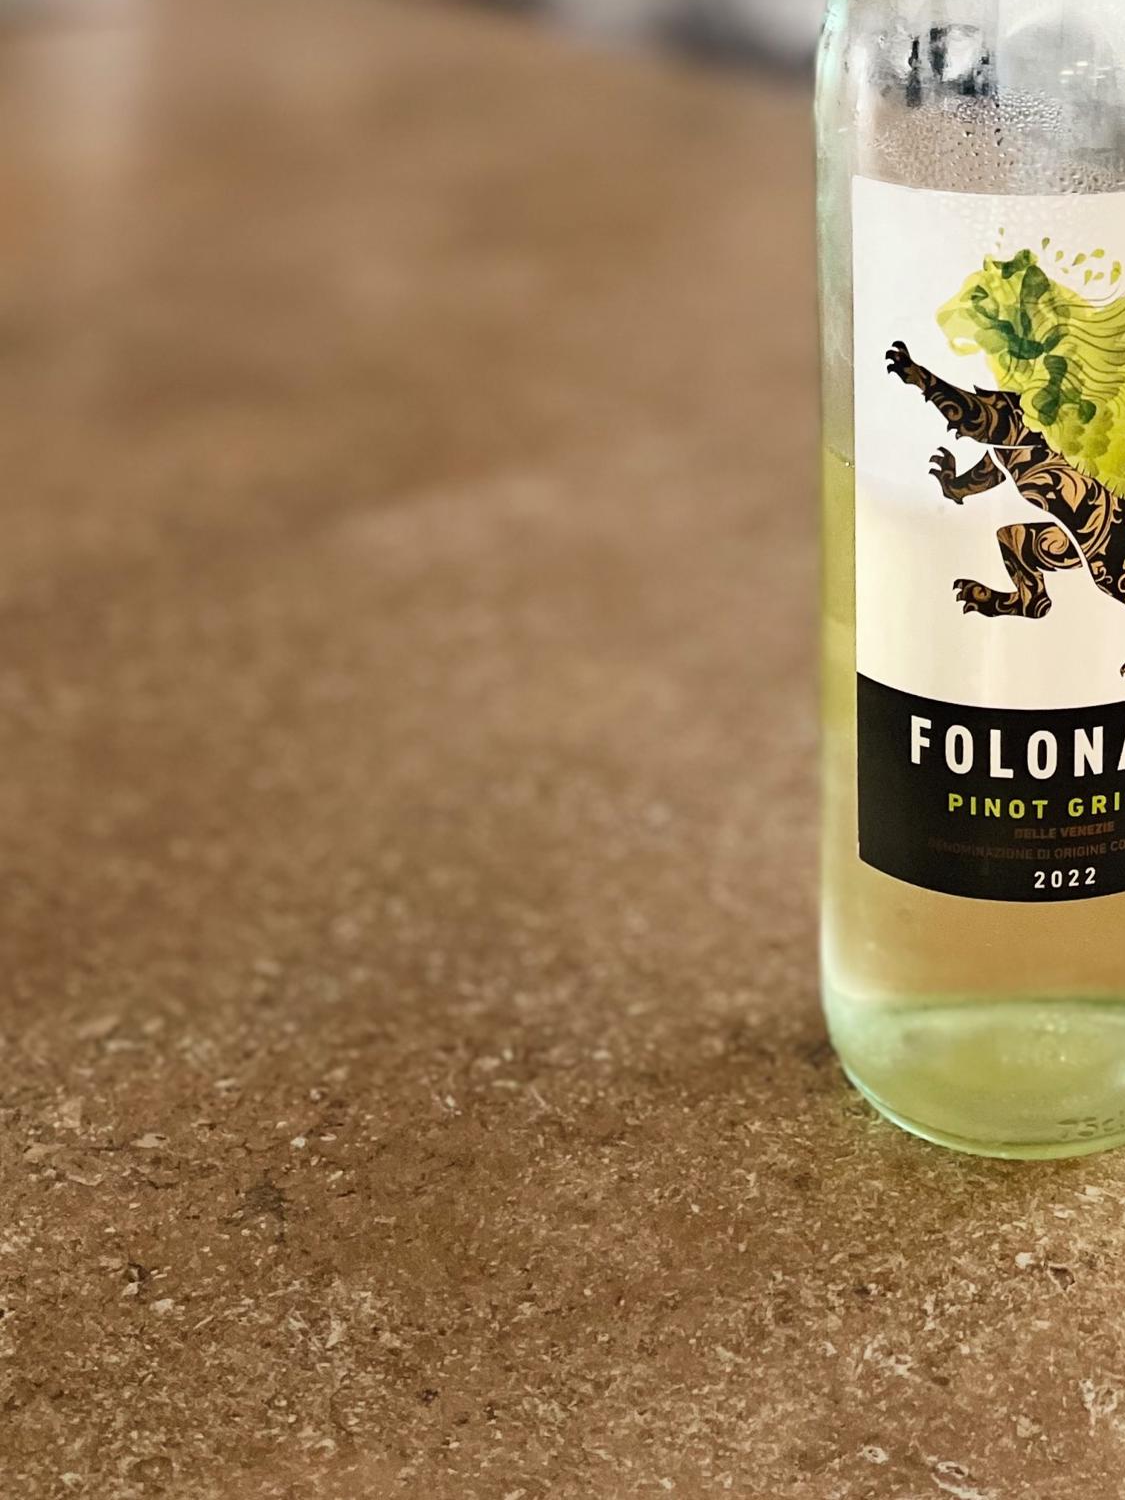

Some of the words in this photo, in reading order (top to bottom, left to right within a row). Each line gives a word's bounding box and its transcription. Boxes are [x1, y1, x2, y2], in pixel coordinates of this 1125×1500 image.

[948, 792, 1048, 819] PINOT
[1014, 827, 1057, 840] DELLE
[1060, 821, 1116, 838] VENEZIE
[1036, 848, 1051, 860] DI
[1053, 842, 1107, 860] ORIGINE
[1034, 866, 1097, 889] 2022
